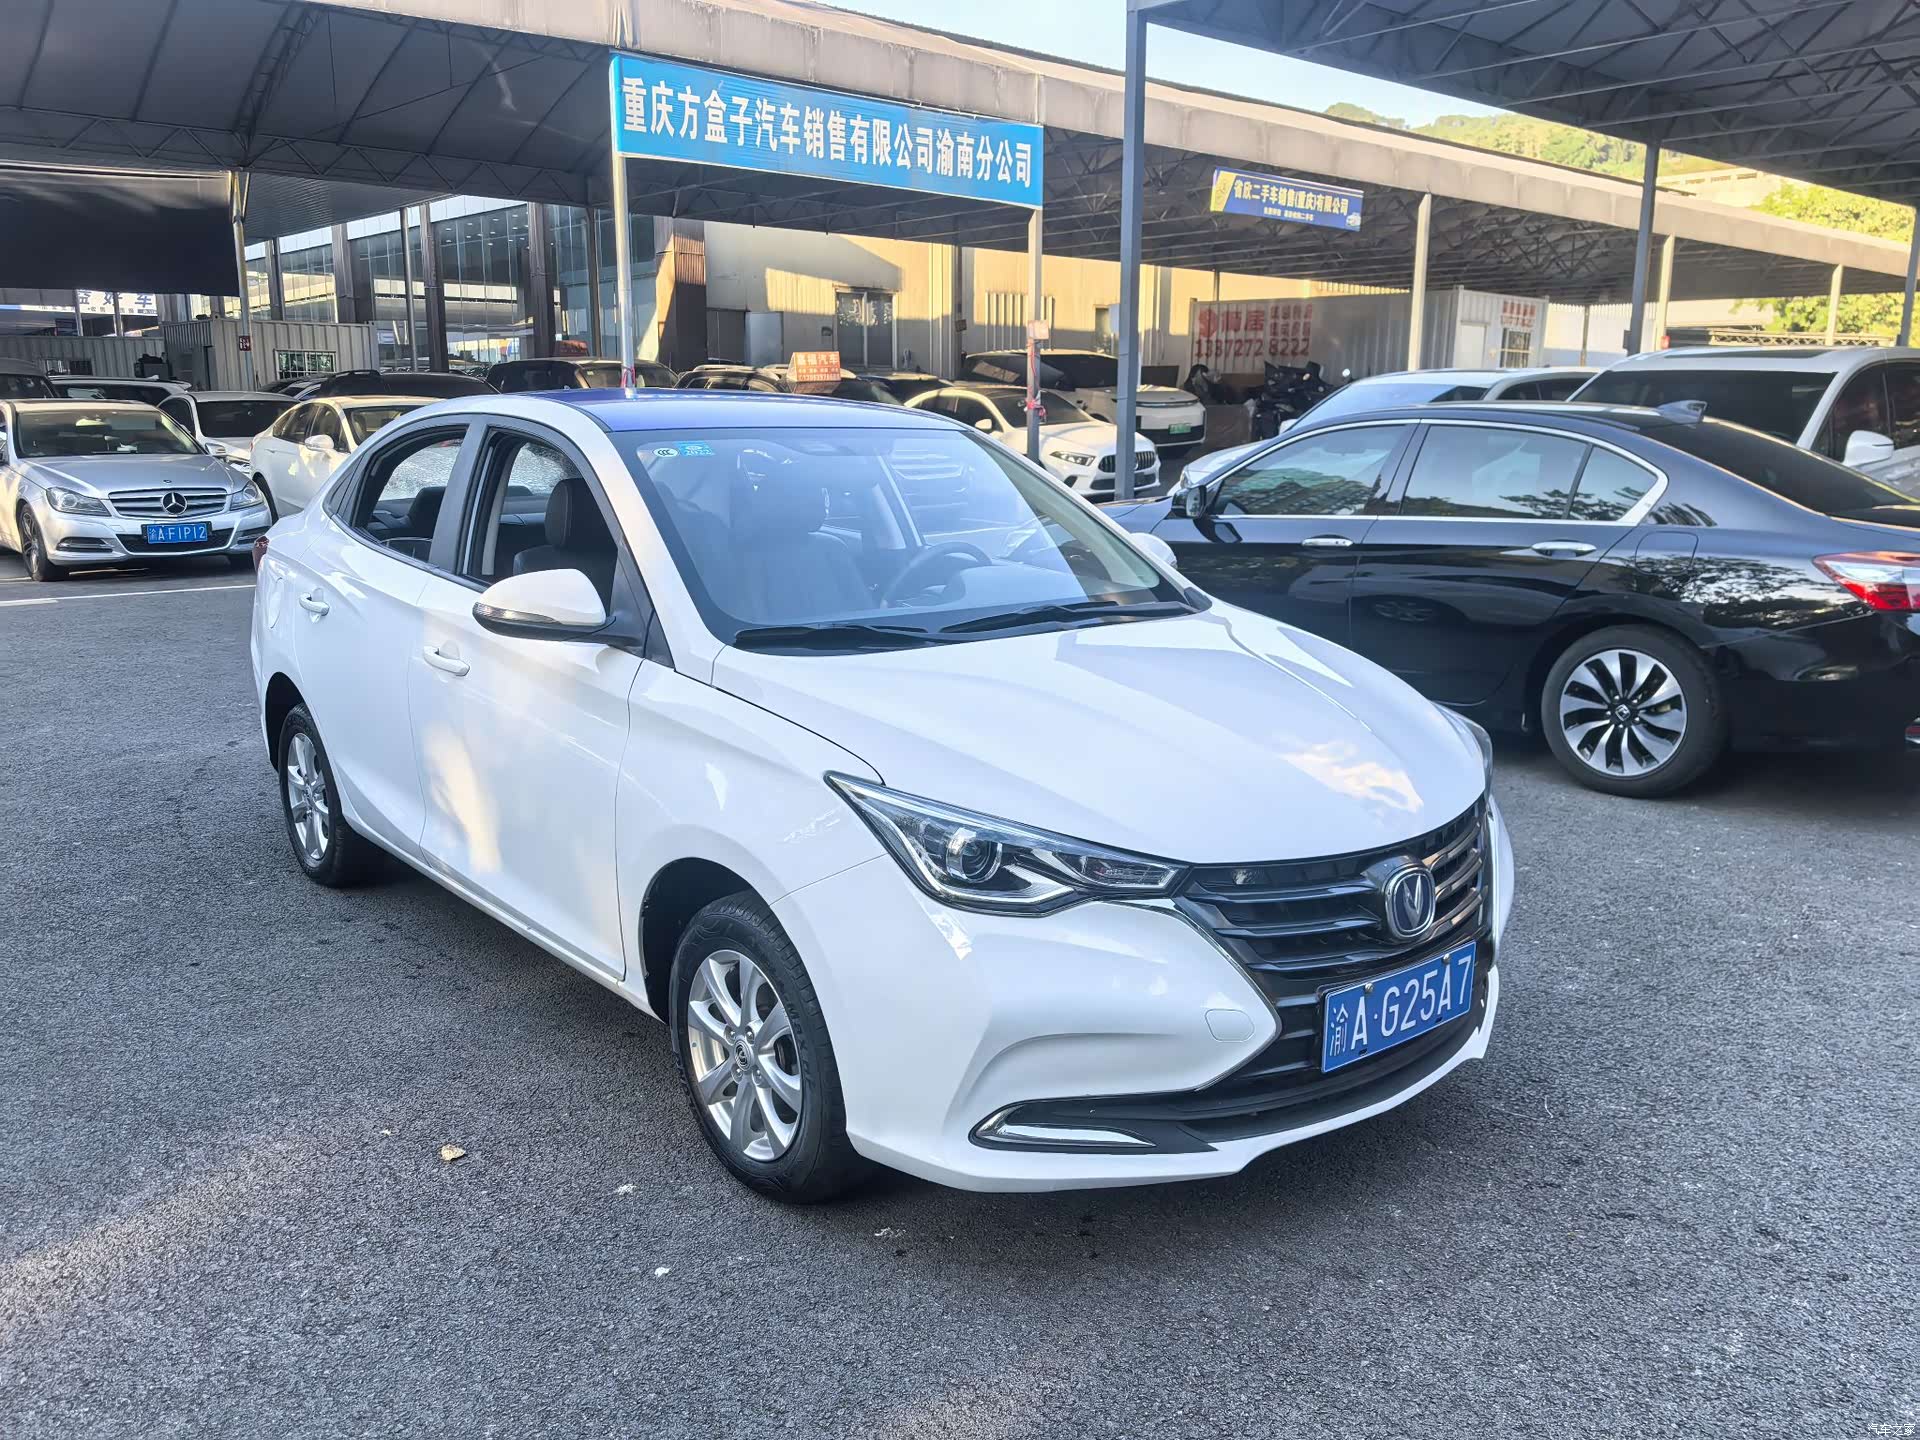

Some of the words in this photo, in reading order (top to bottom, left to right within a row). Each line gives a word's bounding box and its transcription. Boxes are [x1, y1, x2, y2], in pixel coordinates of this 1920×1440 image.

[621, 76, 1032, 188] 重庆方盒子汽车销售有限公司渝南分公司
[1329, 954, 1472, 1057] 渝A·G25A7
